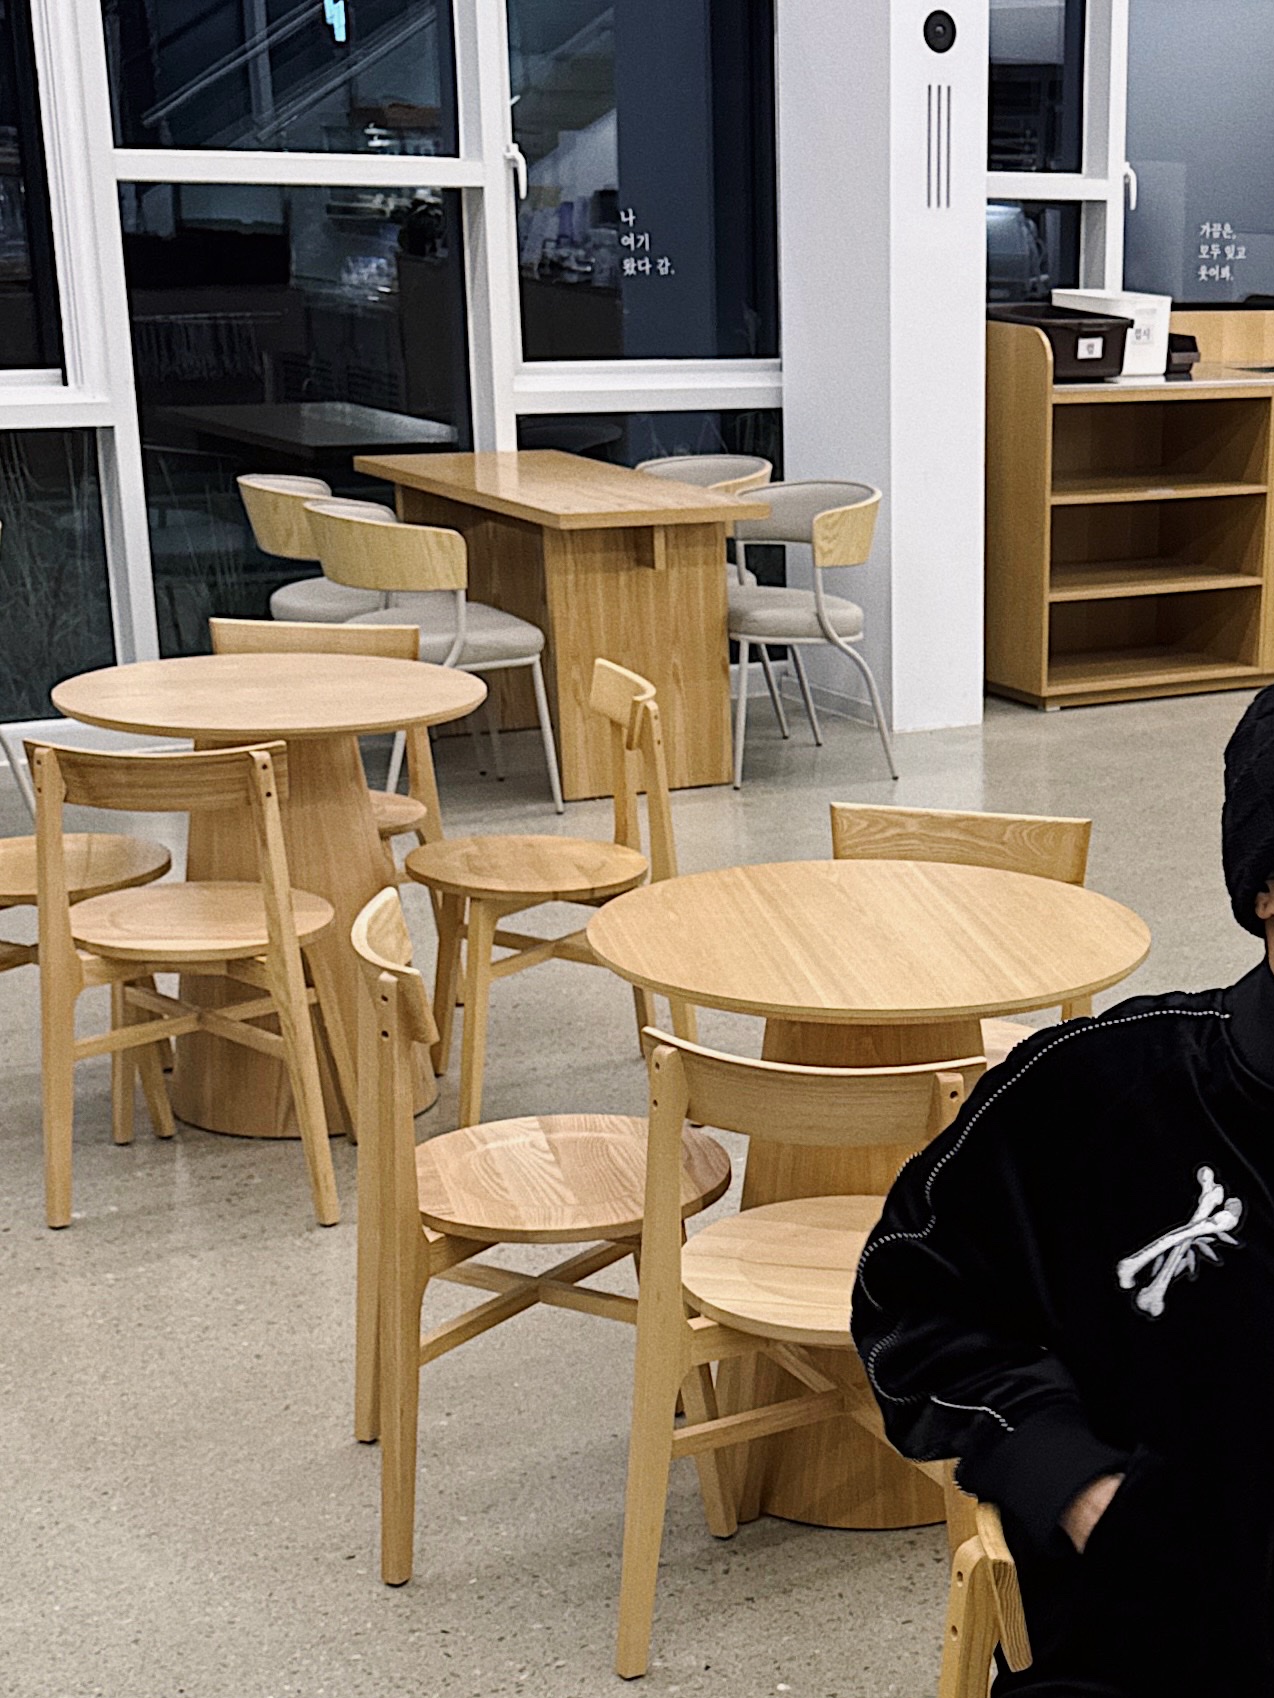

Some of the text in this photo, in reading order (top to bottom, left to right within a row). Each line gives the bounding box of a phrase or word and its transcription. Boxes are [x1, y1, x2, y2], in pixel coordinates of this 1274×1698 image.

[620, 208, 636, 227] 나
[620, 232, 650, 252] 여기
[1198, 244, 1247, 260] 모두 잊고
[623, 256, 675, 276] 왔다 감.
